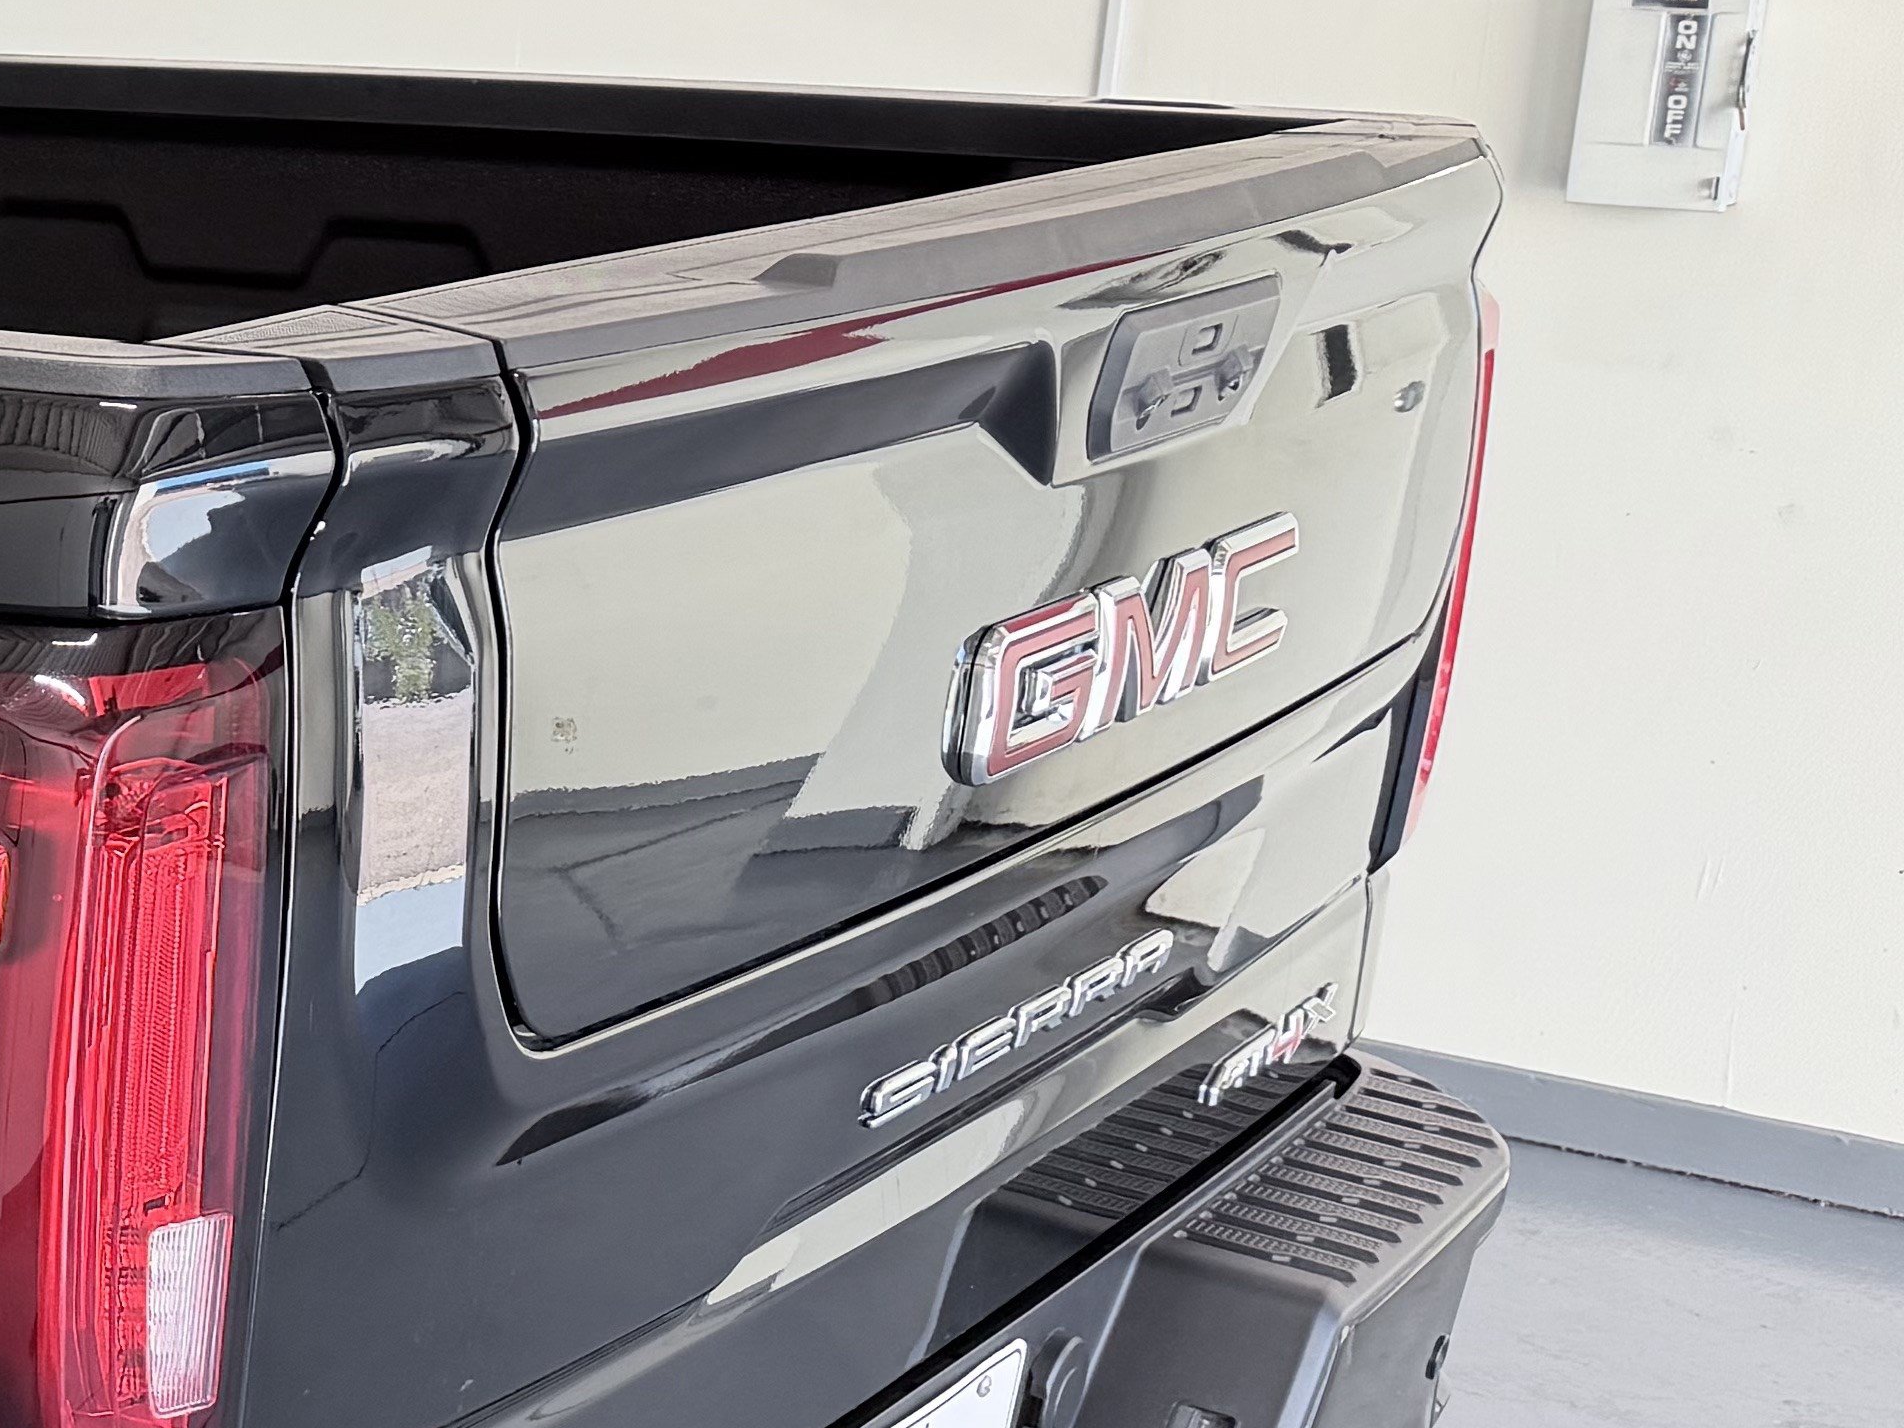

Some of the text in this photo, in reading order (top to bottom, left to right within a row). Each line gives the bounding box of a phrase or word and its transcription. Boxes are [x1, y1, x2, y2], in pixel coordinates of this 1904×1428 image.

[1675, 20, 1698, 50] ON
[1664, 94, 1688, 139] OFF
[941, 511, 1300, 786] GMC
[857, 928, 1175, 1129] SIERRA
[1197, 982, 1339, 1106] AT4X
